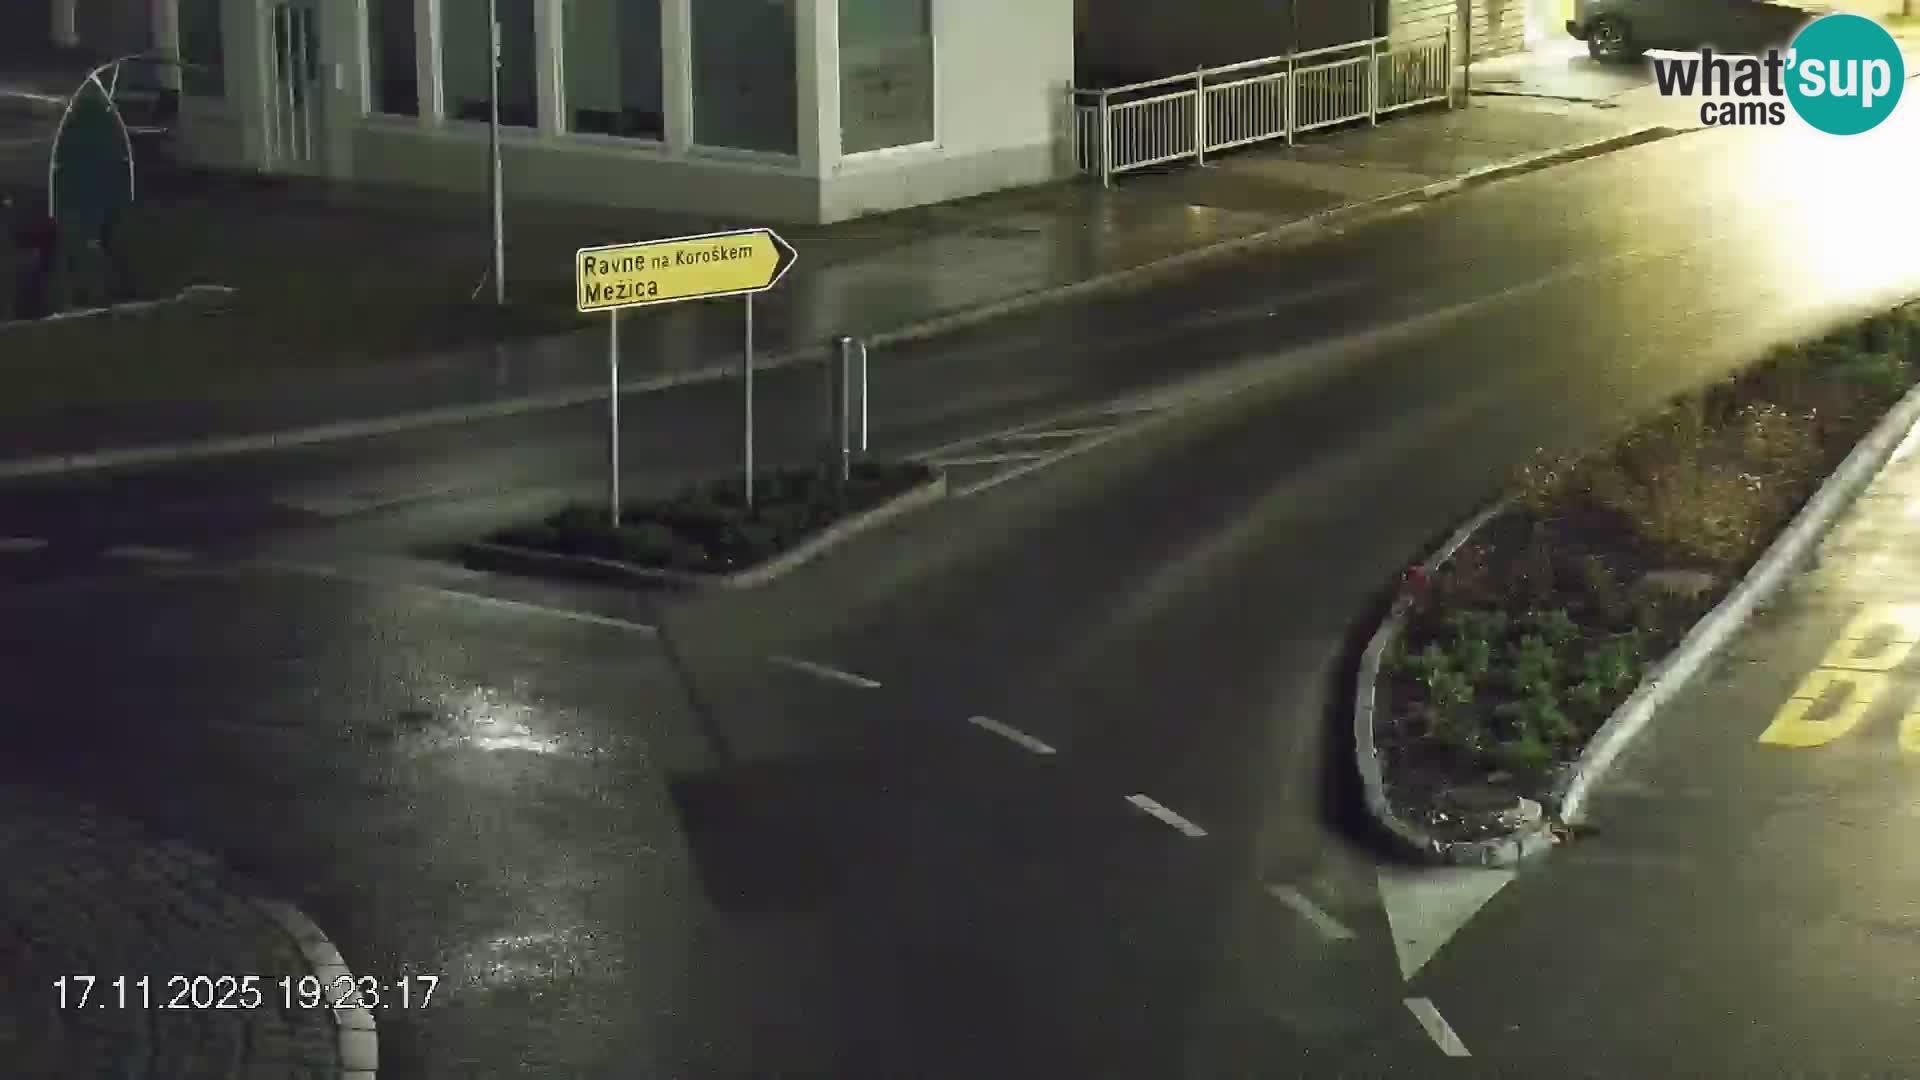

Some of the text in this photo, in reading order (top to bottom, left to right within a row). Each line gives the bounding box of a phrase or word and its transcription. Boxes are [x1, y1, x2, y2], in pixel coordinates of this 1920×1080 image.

[584, 245, 753, 277] Ravne na Koroškem
[584, 279, 658, 305] Mežica
